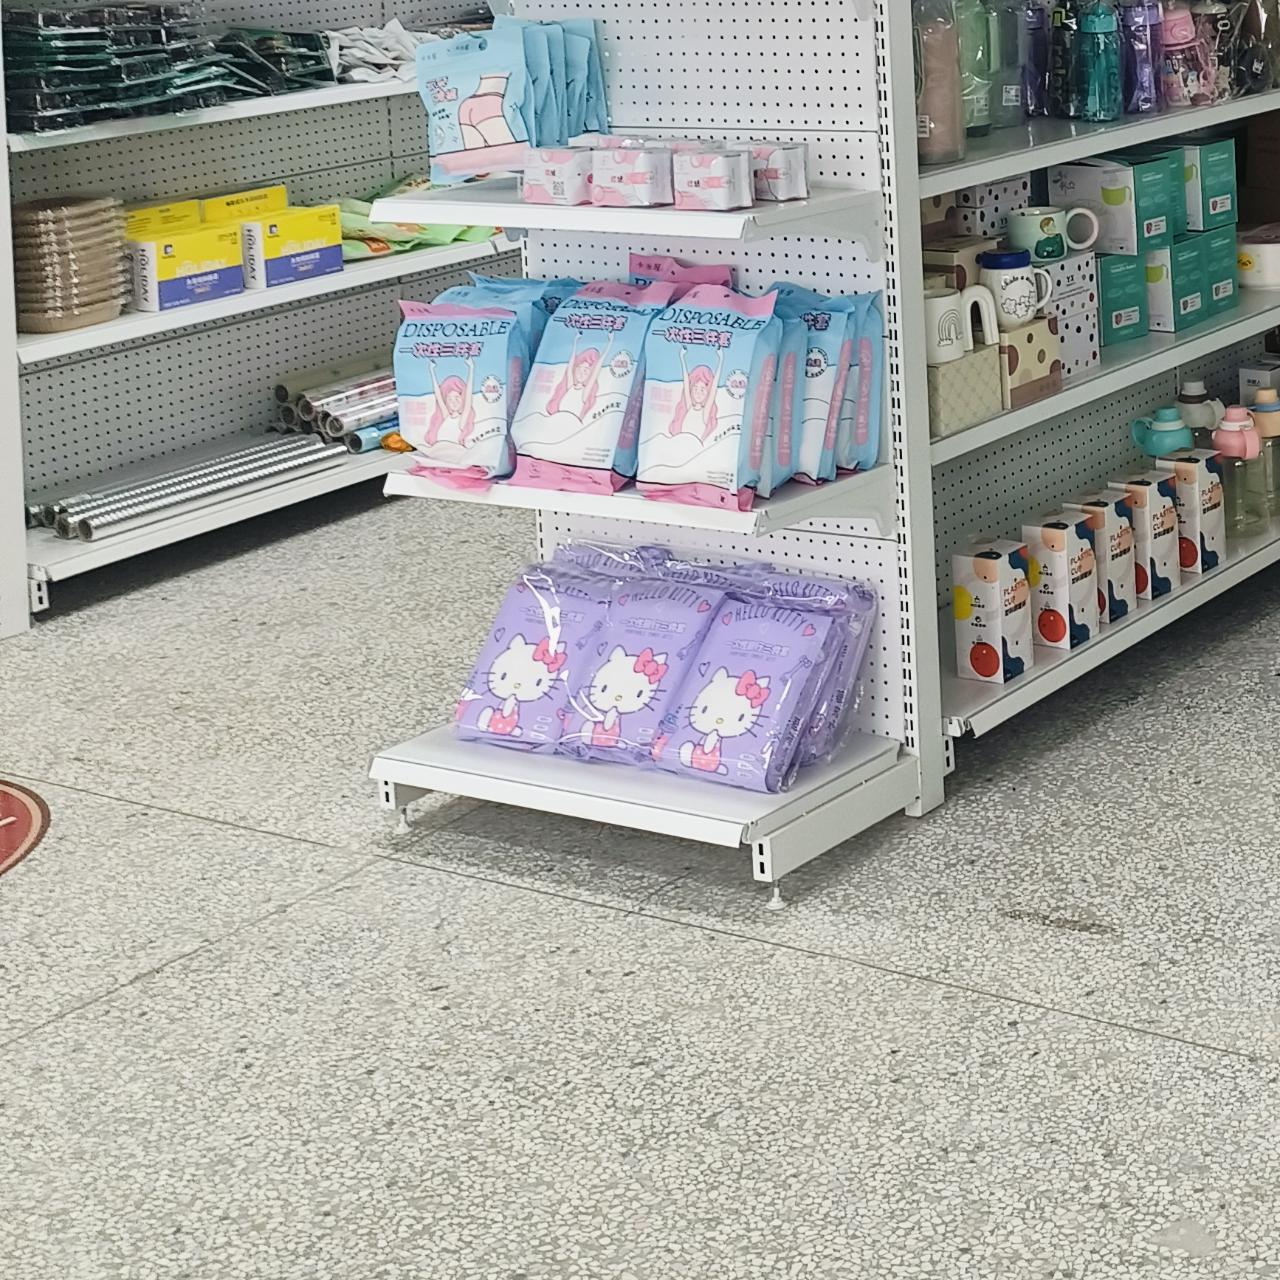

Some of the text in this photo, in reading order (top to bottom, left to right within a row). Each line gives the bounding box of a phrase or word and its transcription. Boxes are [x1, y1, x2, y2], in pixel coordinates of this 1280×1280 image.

[659, 307, 766, 331] DISPOSABLE
[402, 320, 511, 339] DISPOSABLE
[651, 326, 734, 348] 一次性三件套
[1201, 482, 1221, 497] PLASTIC
[1152, 506, 1175, 522] PLASTIC
[1109, 526, 1131, 543] PLASTIC
[1070, 548, 1092, 566] PLASTIC
[631, 586, 670, 601] HELLO
[668, 586, 702, 608] KITTY
[1003, 578, 1026, 597] PLASTIC
[770, 607, 808, 632] KITTY
